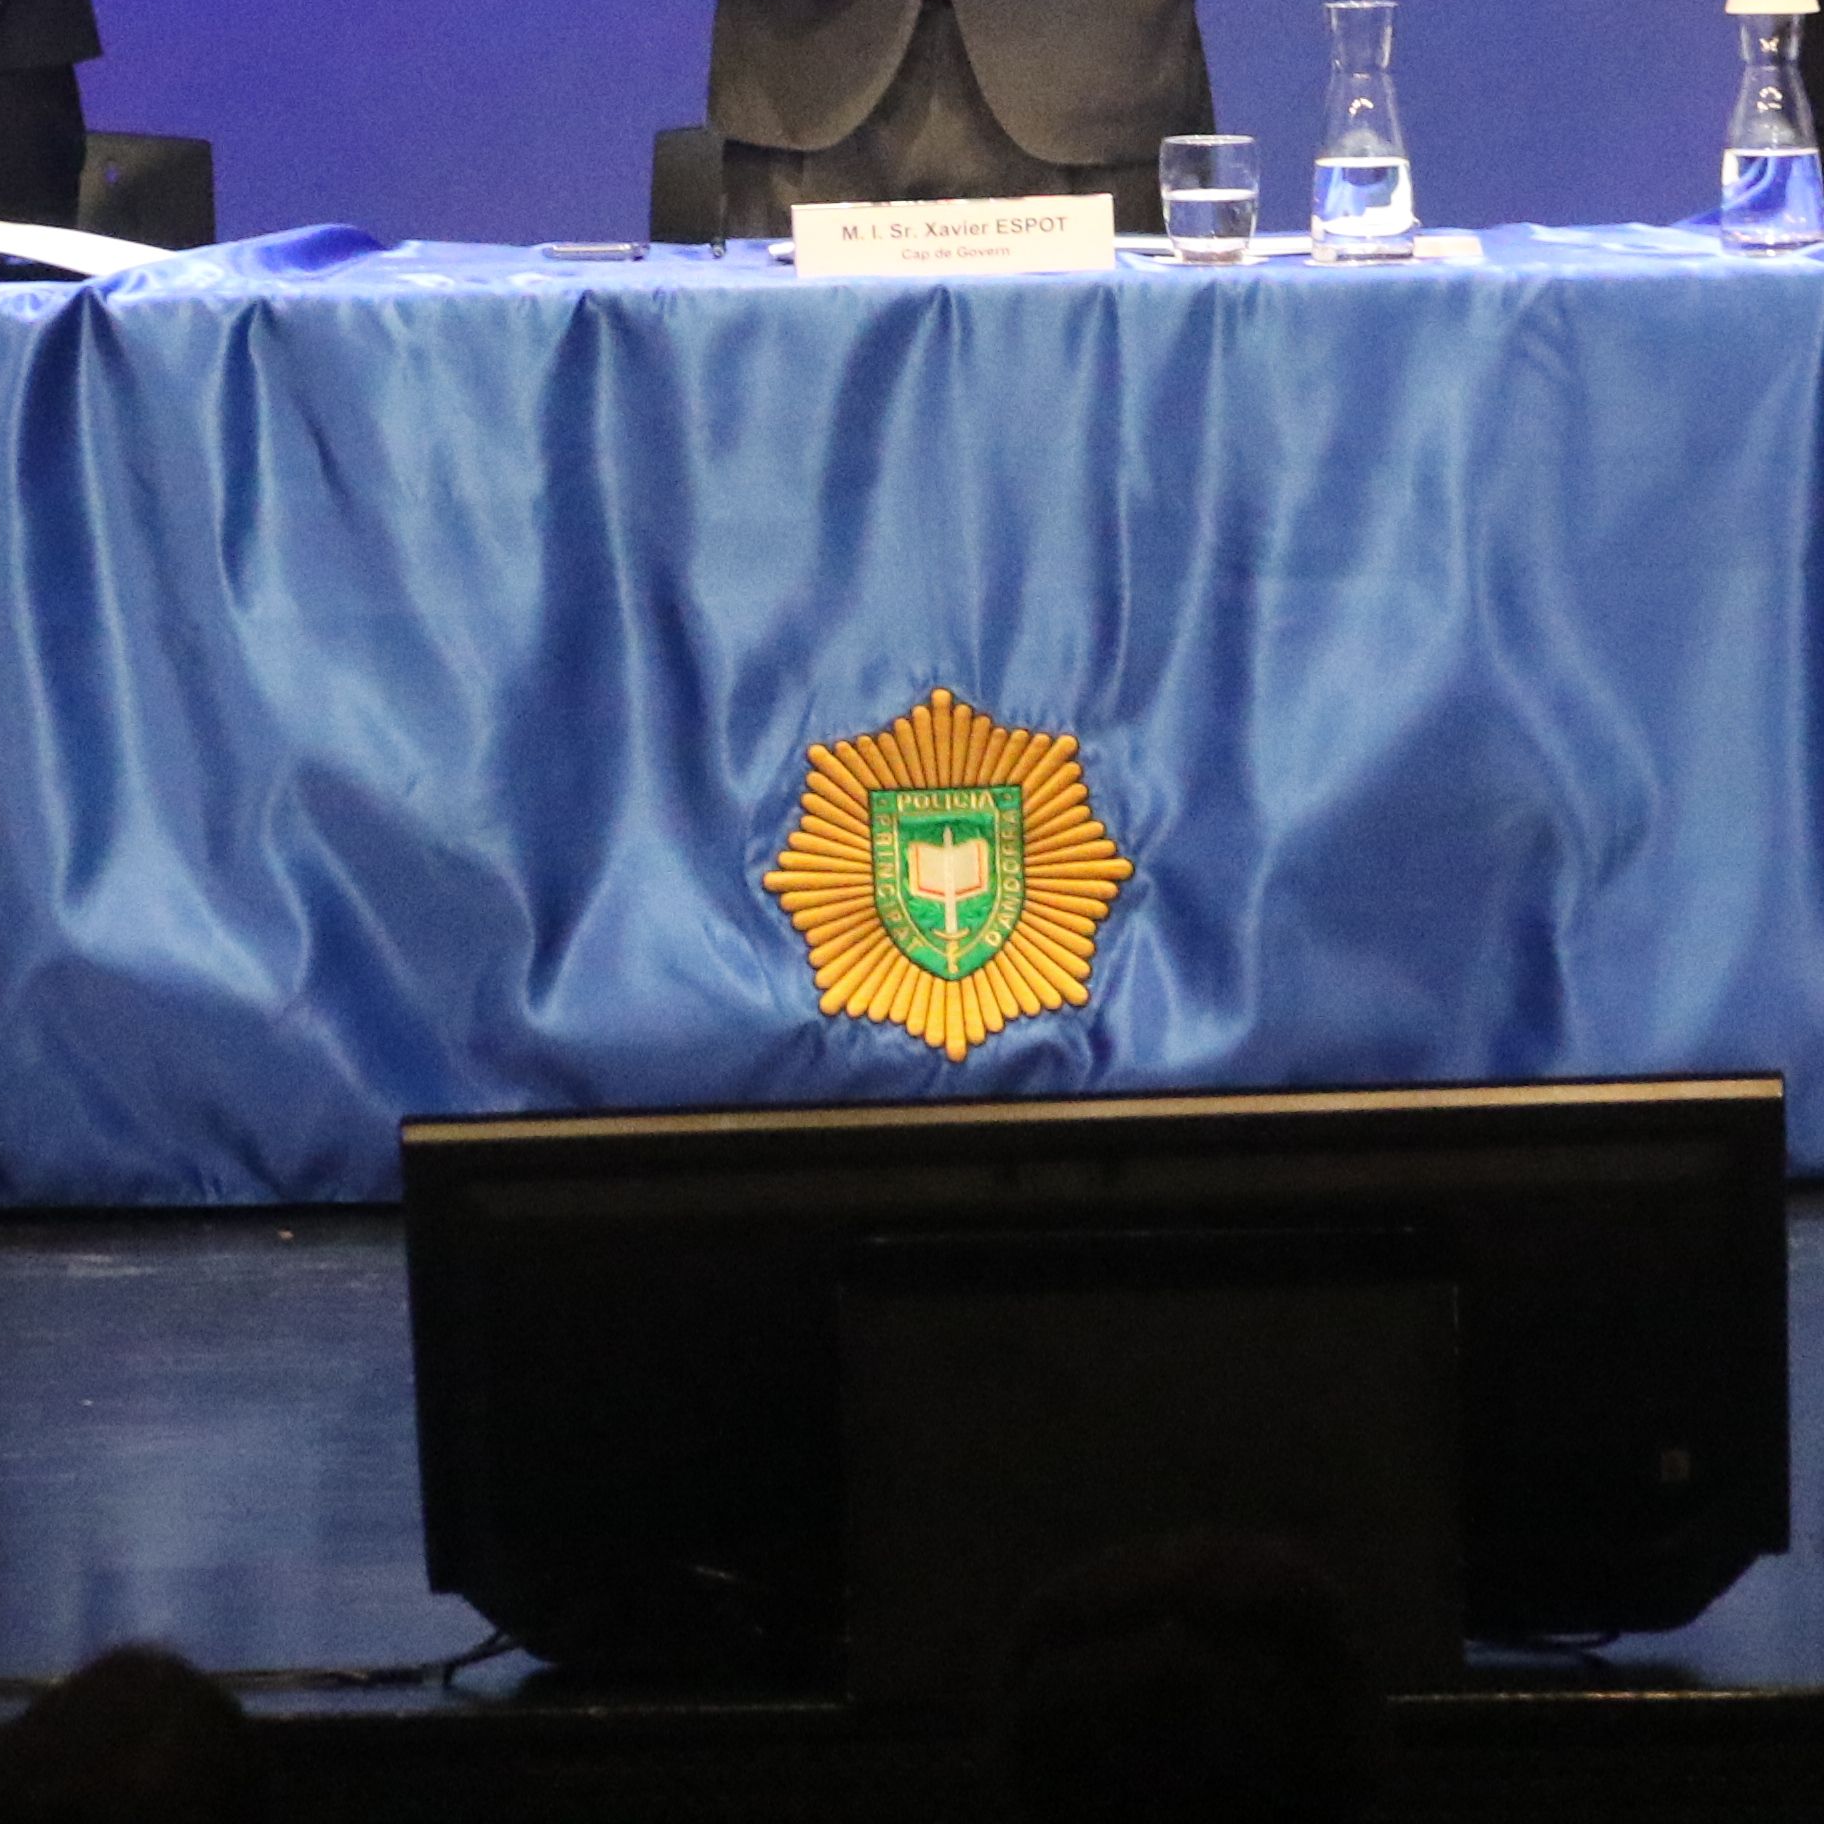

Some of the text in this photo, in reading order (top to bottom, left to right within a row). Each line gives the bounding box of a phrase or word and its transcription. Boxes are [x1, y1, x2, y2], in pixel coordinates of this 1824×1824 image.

[841, 216, 1068, 241] M. I. Sr. Xavier ESPOT
[901, 245, 1010, 261] Cap de Govern
[896, 789, 994, 811] POLICIA
